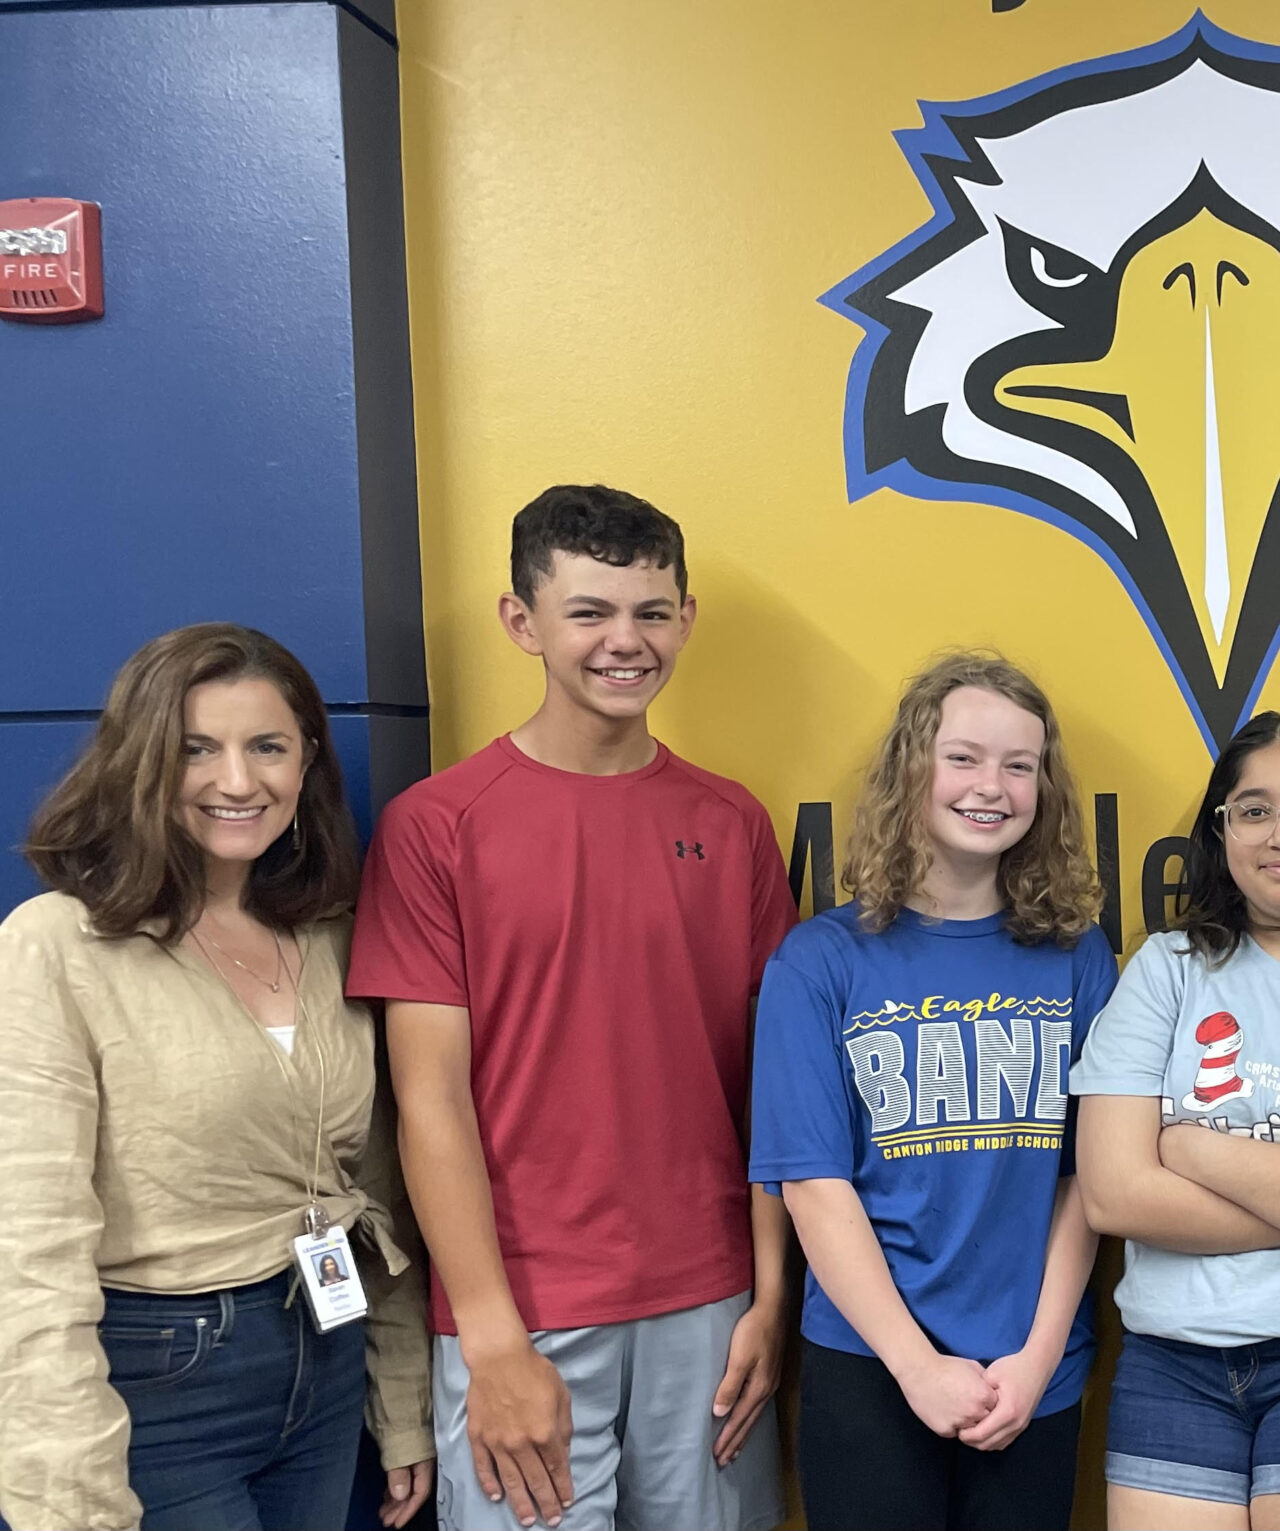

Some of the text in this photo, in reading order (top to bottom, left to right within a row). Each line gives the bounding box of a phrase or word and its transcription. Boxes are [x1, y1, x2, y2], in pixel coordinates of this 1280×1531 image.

[4, 263, 58, 278] FIRE
[921, 993, 1023, 1022] Eagle
[1245, 1060, 1280, 1078] CRMS
[883, 1142, 932, 1160] CANYON
[1016, 1135, 1062, 1149] SCHOOL
